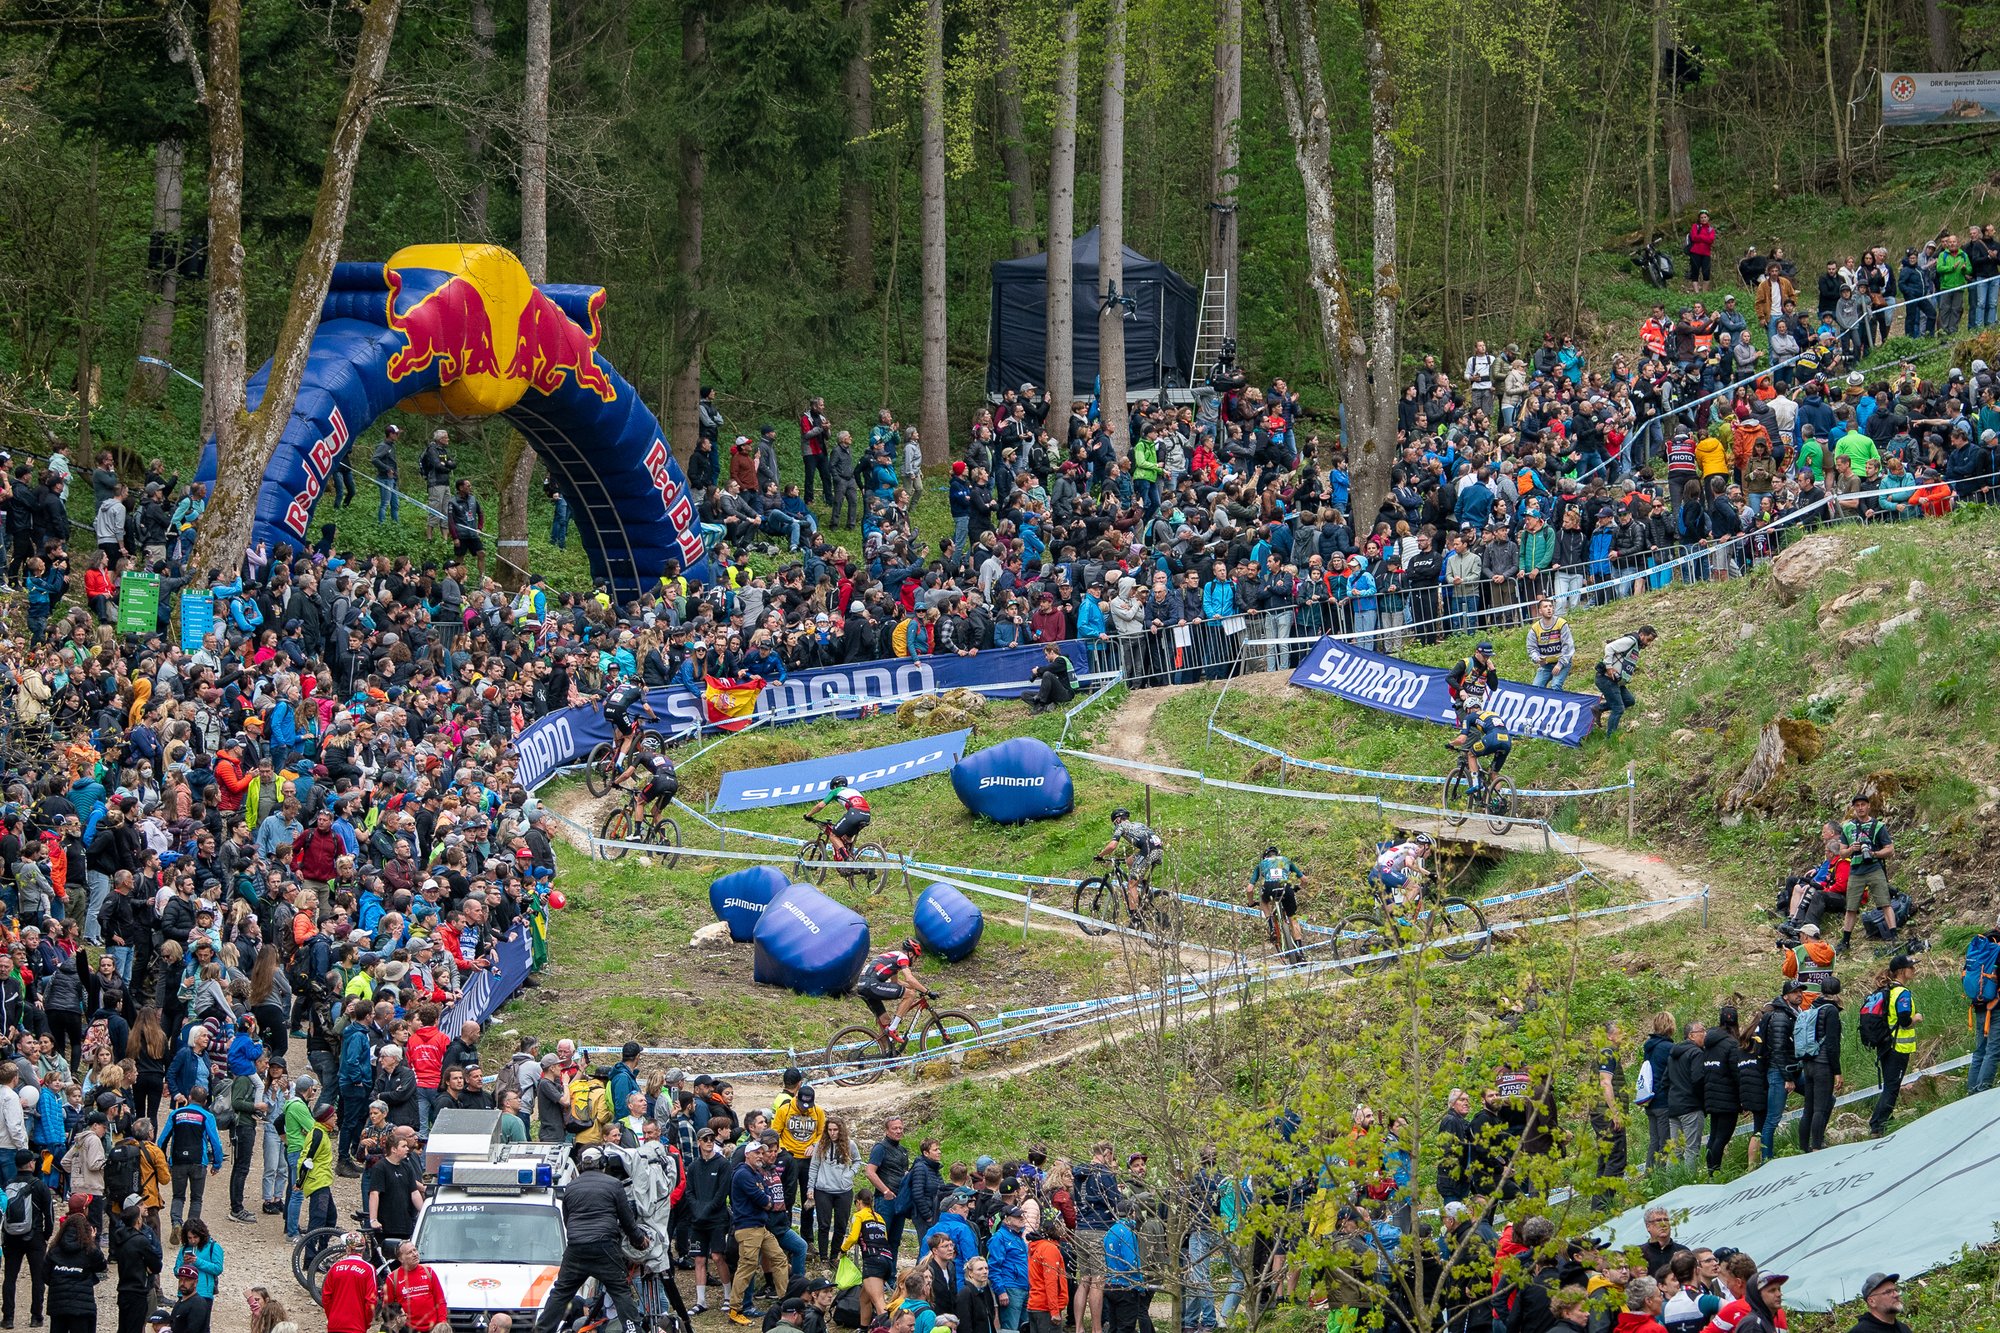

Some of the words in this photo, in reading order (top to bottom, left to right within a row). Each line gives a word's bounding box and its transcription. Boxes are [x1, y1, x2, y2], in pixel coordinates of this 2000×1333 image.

[284, 459, 320, 538] Red
[308, 405, 349, 480] Bull
[643, 438, 682, 511] Red
[668, 495, 704, 567] Bull
[1307, 648, 1431, 710] SHIMANO
[667, 663, 936, 734] SMANO
[978, 775, 1045, 790] SHIMANO
[1509, 889, 1541, 900] SHIMANO
[781, 901, 821, 935] SHIMANO
[927, 897, 952, 923] SHIMANO
[1003, 1008, 1038, 1018] SHIMANO
[1044, 1003, 1079, 1013] SHIMANO
[789, 1120, 815, 1131] DENIM
[335, 1264, 350, 1272] TSV
